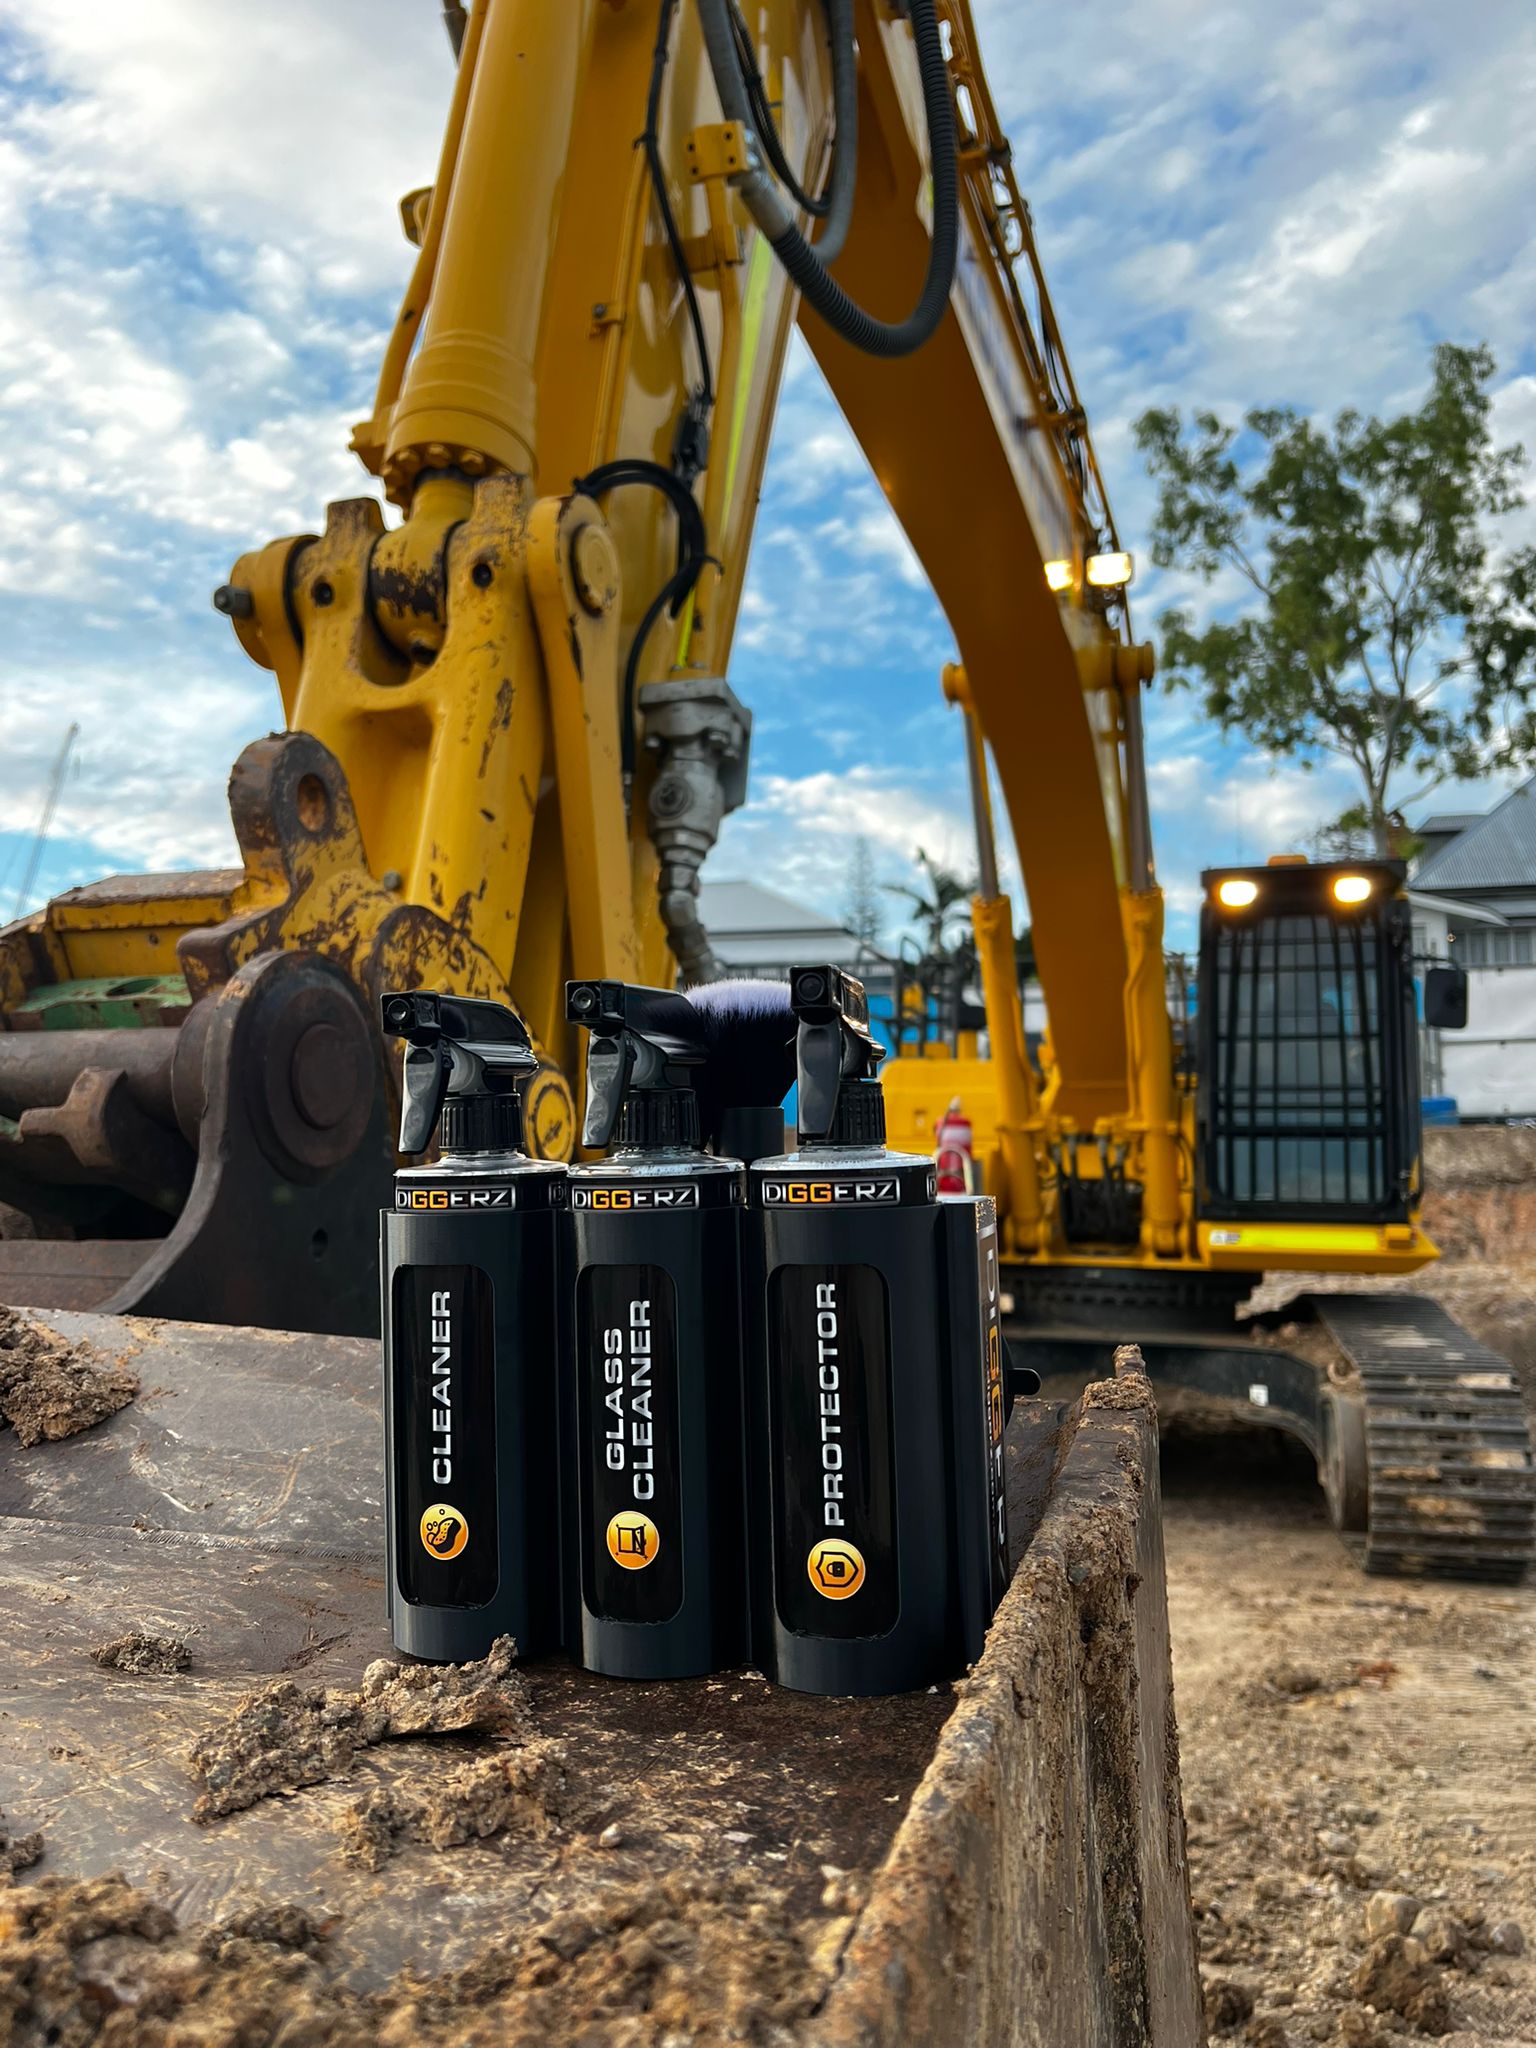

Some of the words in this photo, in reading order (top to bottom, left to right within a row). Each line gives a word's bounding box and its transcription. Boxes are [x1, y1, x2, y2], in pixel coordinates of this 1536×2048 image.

[397, 1188, 510, 1208] DIGGERZ
[574, 1188, 693, 1209] DIGGERZ
[765, 1181, 894, 1203] DIGGERZ
[431, 1291, 452, 1485] CLEANER
[603, 1328, 625, 1471] GLASS
[629, 1299, 654, 1500] CLEANER
[815, 1282, 845, 1527] PROTECTOR
